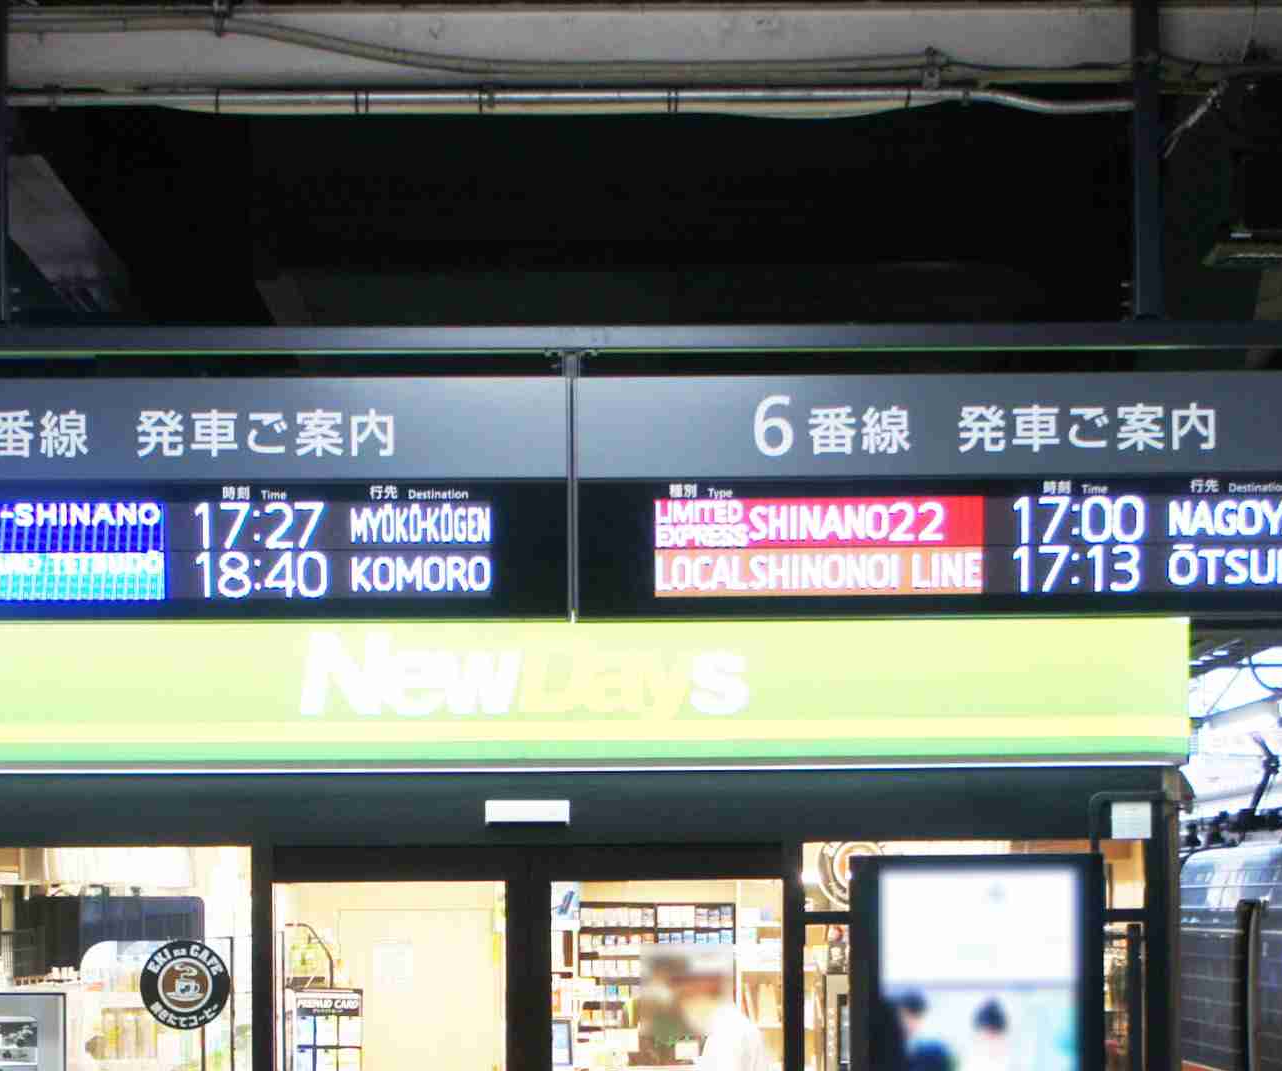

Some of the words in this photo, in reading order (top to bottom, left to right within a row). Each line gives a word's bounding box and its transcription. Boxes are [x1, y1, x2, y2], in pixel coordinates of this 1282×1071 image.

[137, 408, 396, 458] 発車ご案内
[957, 402, 1217, 453] 発車ご案内
[261, 490, 287, 501] Time
[370, 485, 398, 500] 行先
[408, 488, 469, 501] Destination
[708, 488, 733, 501] Type
[1082, 484, 1108, 495] Time
[1190, 480, 1219, 494] 行先
[194, 502, 325, 550] 17:27
[655, 499, 744, 524] LIMITED
[1012, 495, 1146, 545] 17:00
[655, 524, 749, 548] EXPRESS
[194, 550, 328, 599] 18:40
[350, 556, 492, 592] KOMORO
[655, 555, 748, 592] LOCAL
[747, 554, 901, 591] SHINONOI
[910, 553, 984, 589] LINE
[1012, 544, 1142, 593] 17:13
[299, 630, 751, 720] NewDays
